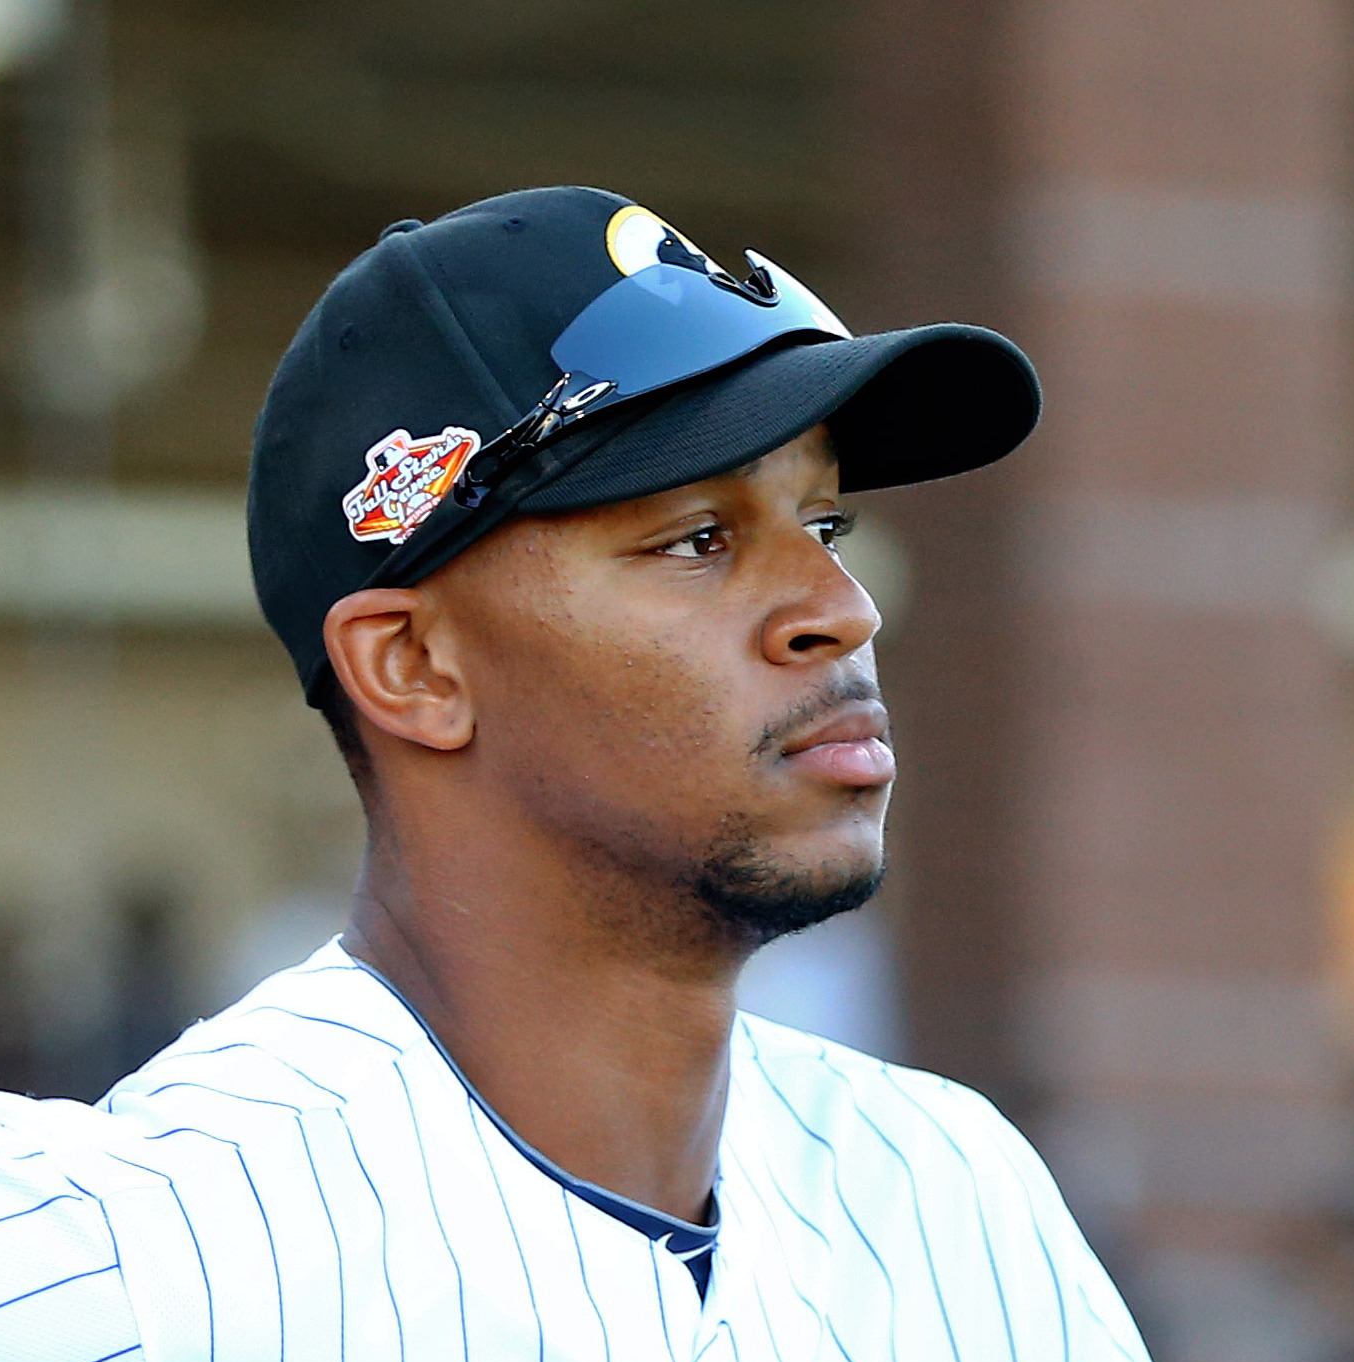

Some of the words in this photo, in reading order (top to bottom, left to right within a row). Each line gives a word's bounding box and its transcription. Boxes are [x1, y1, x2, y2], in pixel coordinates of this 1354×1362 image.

[347, 480, 393, 524] Fall
[390, 434, 464, 490] Stars
[382, 465, 447, 524] Game
